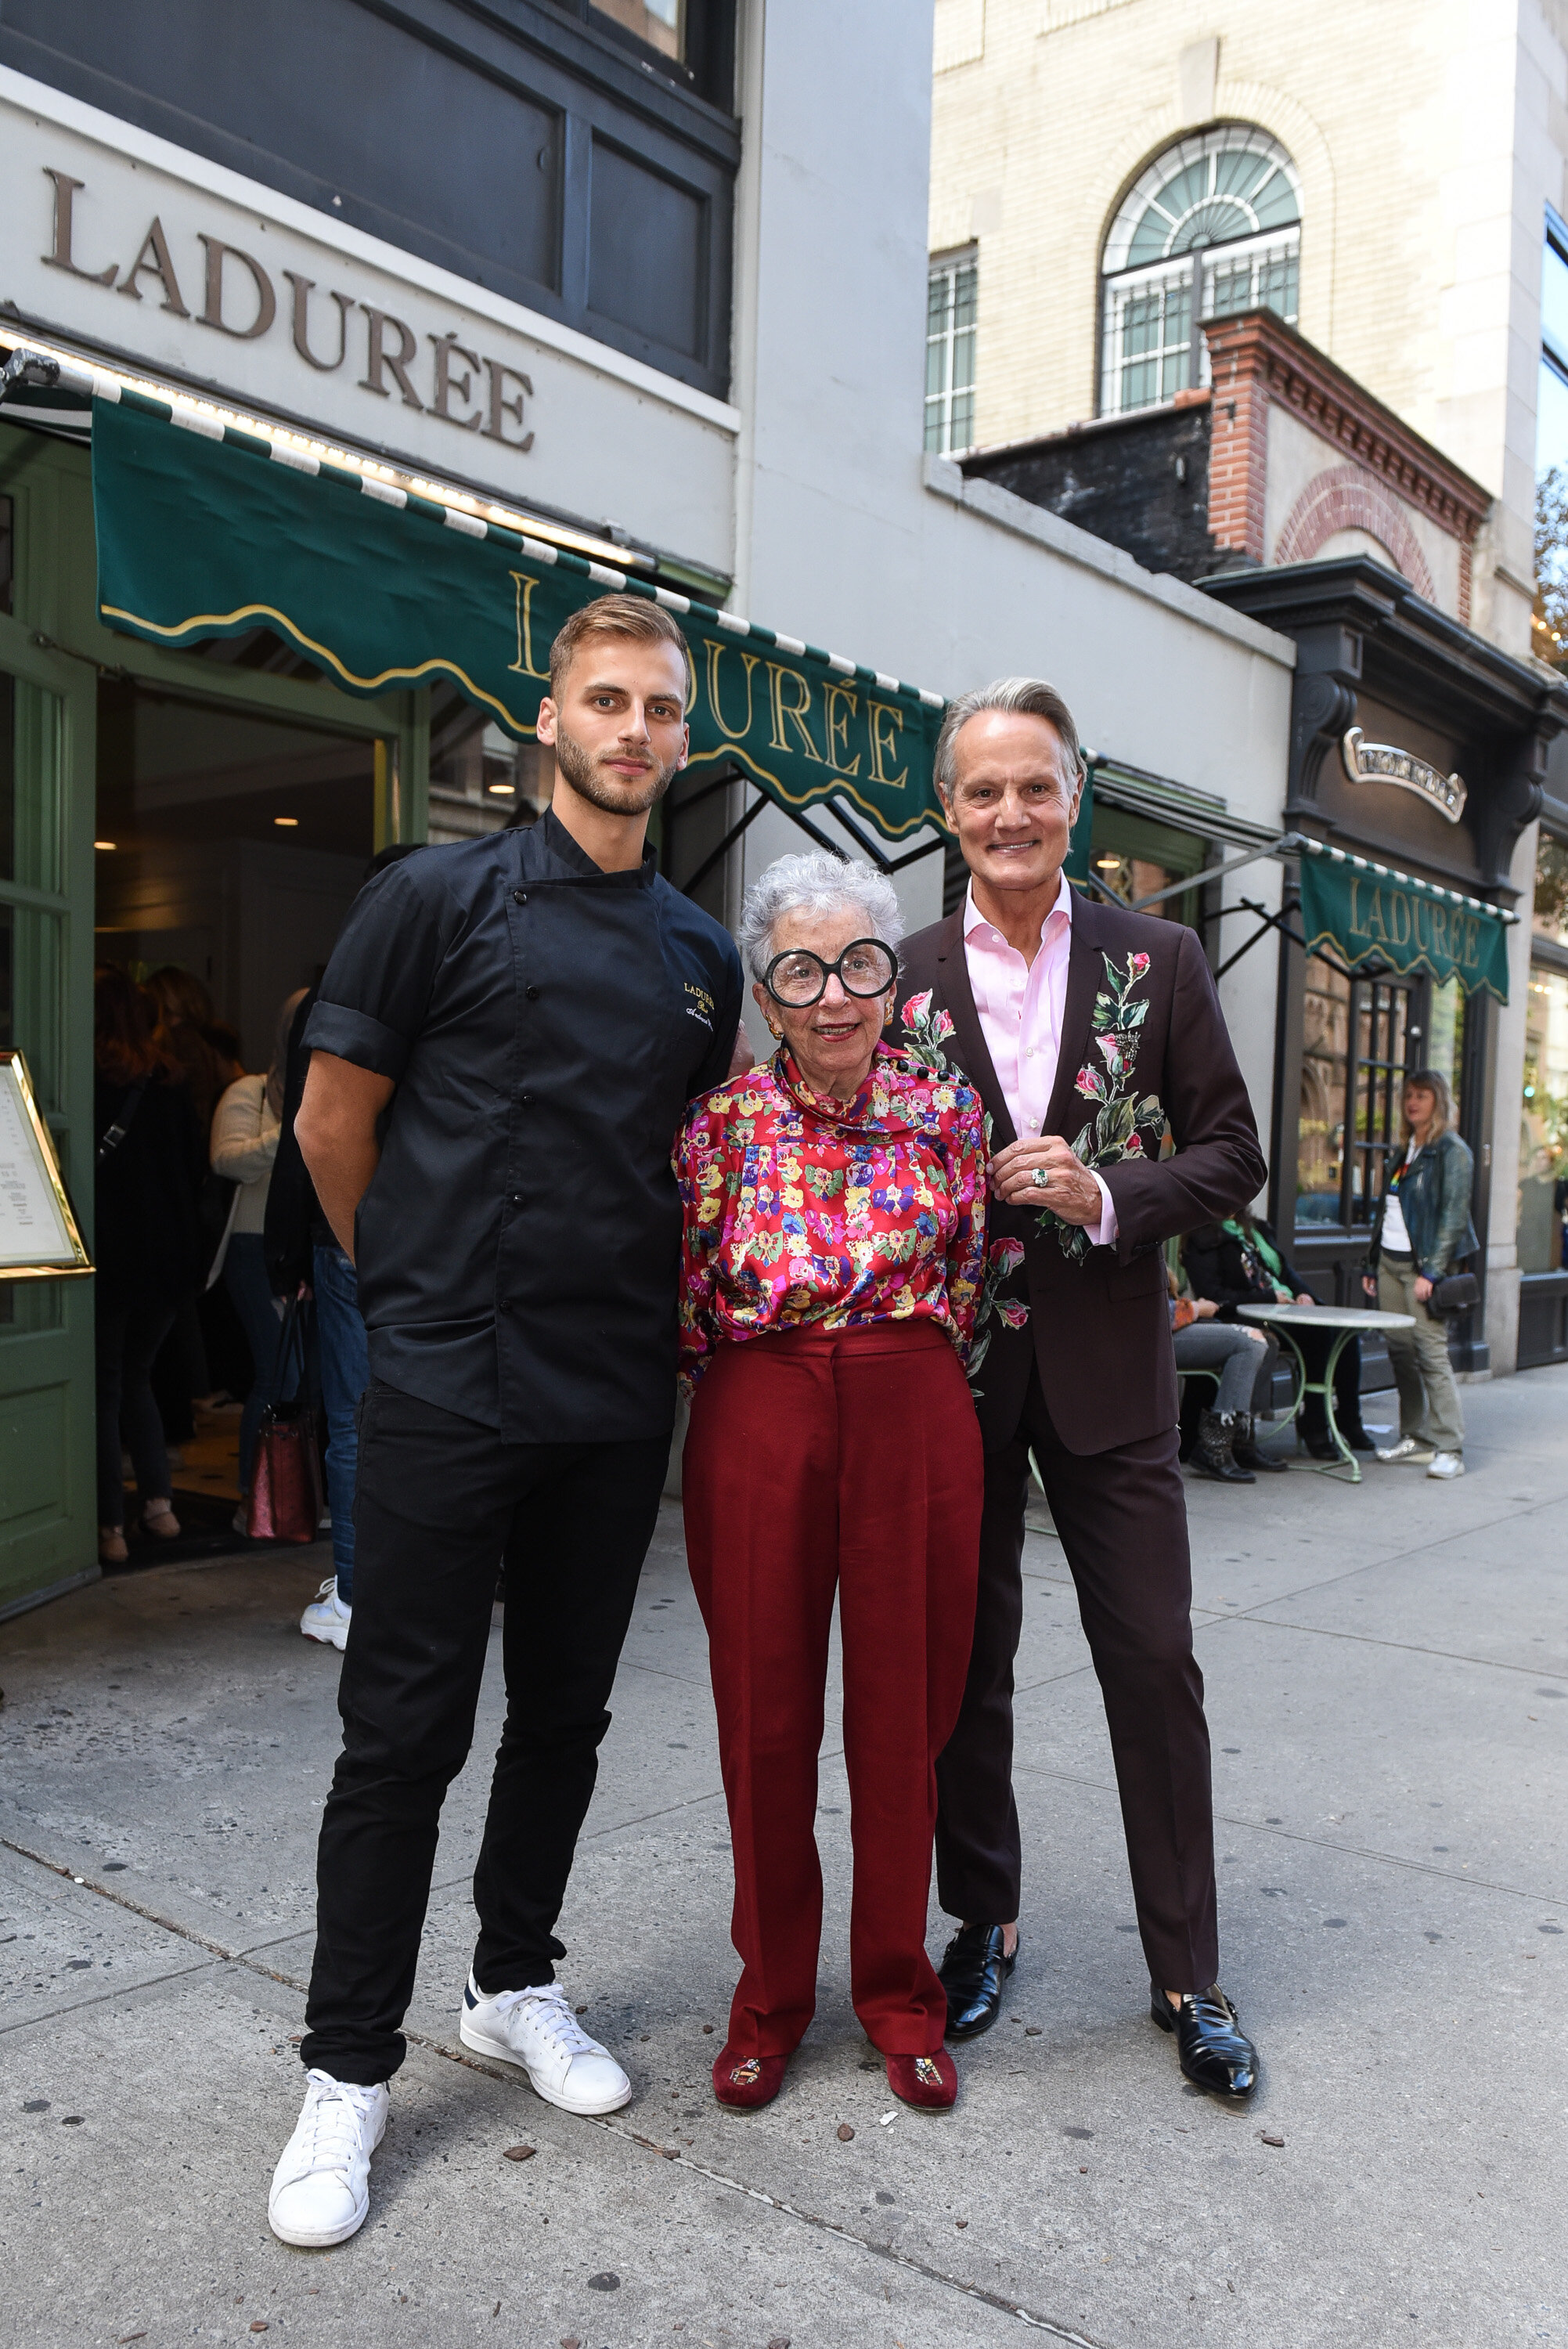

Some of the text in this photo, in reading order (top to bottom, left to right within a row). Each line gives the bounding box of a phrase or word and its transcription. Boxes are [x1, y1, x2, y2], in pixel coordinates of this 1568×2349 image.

[41, 166, 535, 451] LADURÉE
[508, 571, 909, 788] LURÉE
[1350, 878, 1481, 968] LADURÉE
